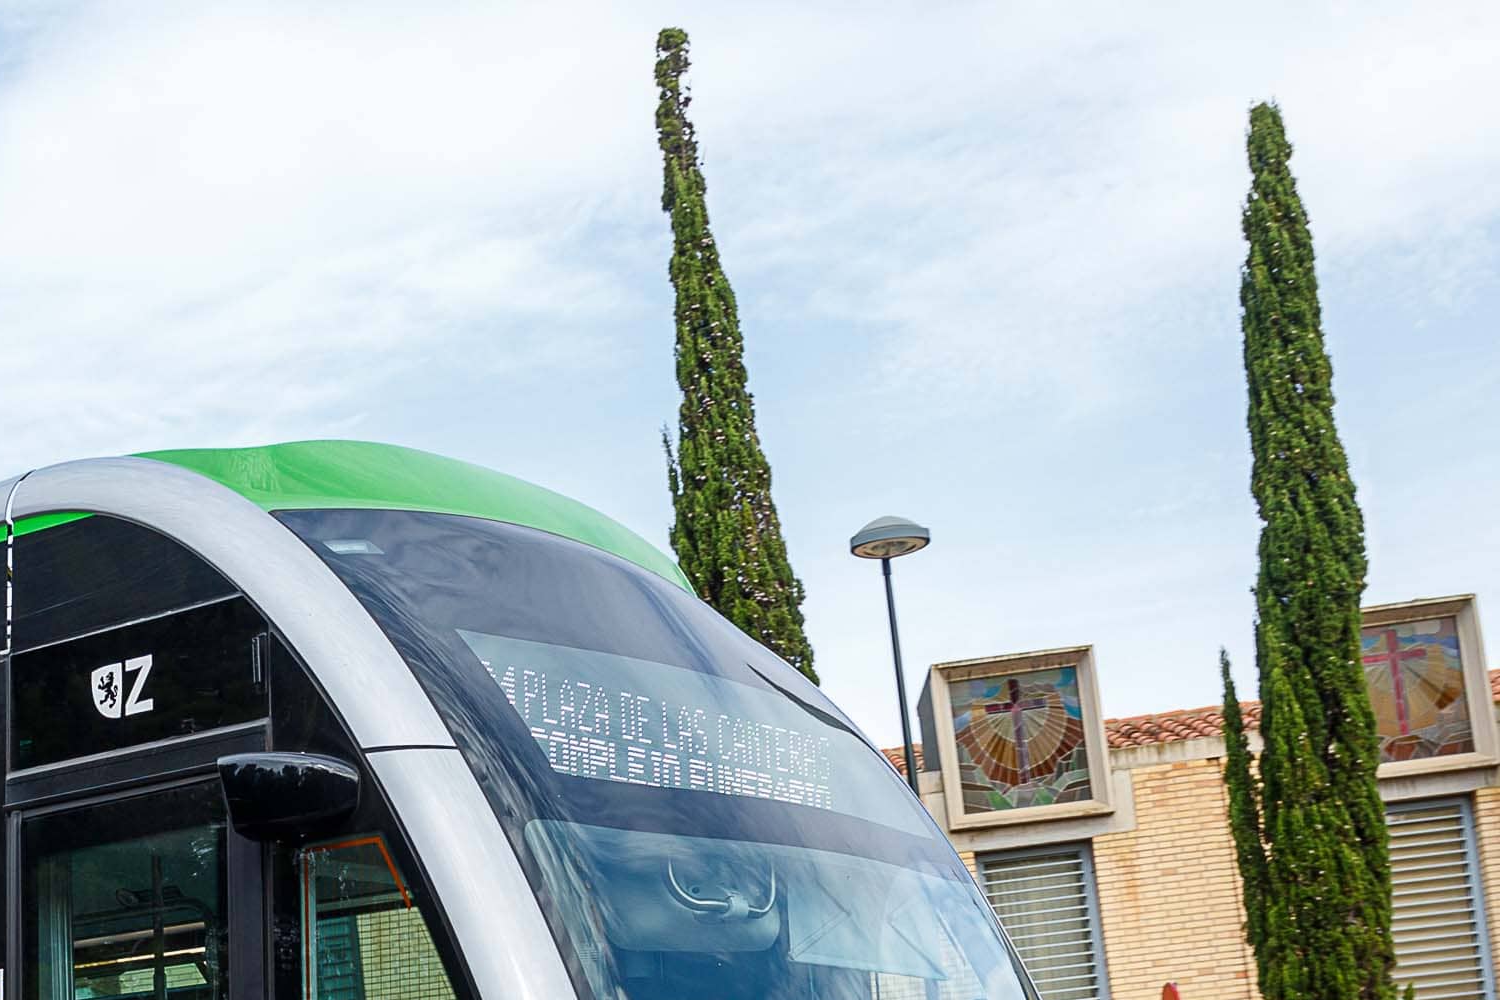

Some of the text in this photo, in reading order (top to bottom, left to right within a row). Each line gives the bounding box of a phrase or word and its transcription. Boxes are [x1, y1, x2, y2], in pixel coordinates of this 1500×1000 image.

[523, 670, 610, 736] PLAZA
[621, 692, 651, 744] DE
[662, 702, 708, 755] LAS
[719, 715, 831, 779] CANTERAS
